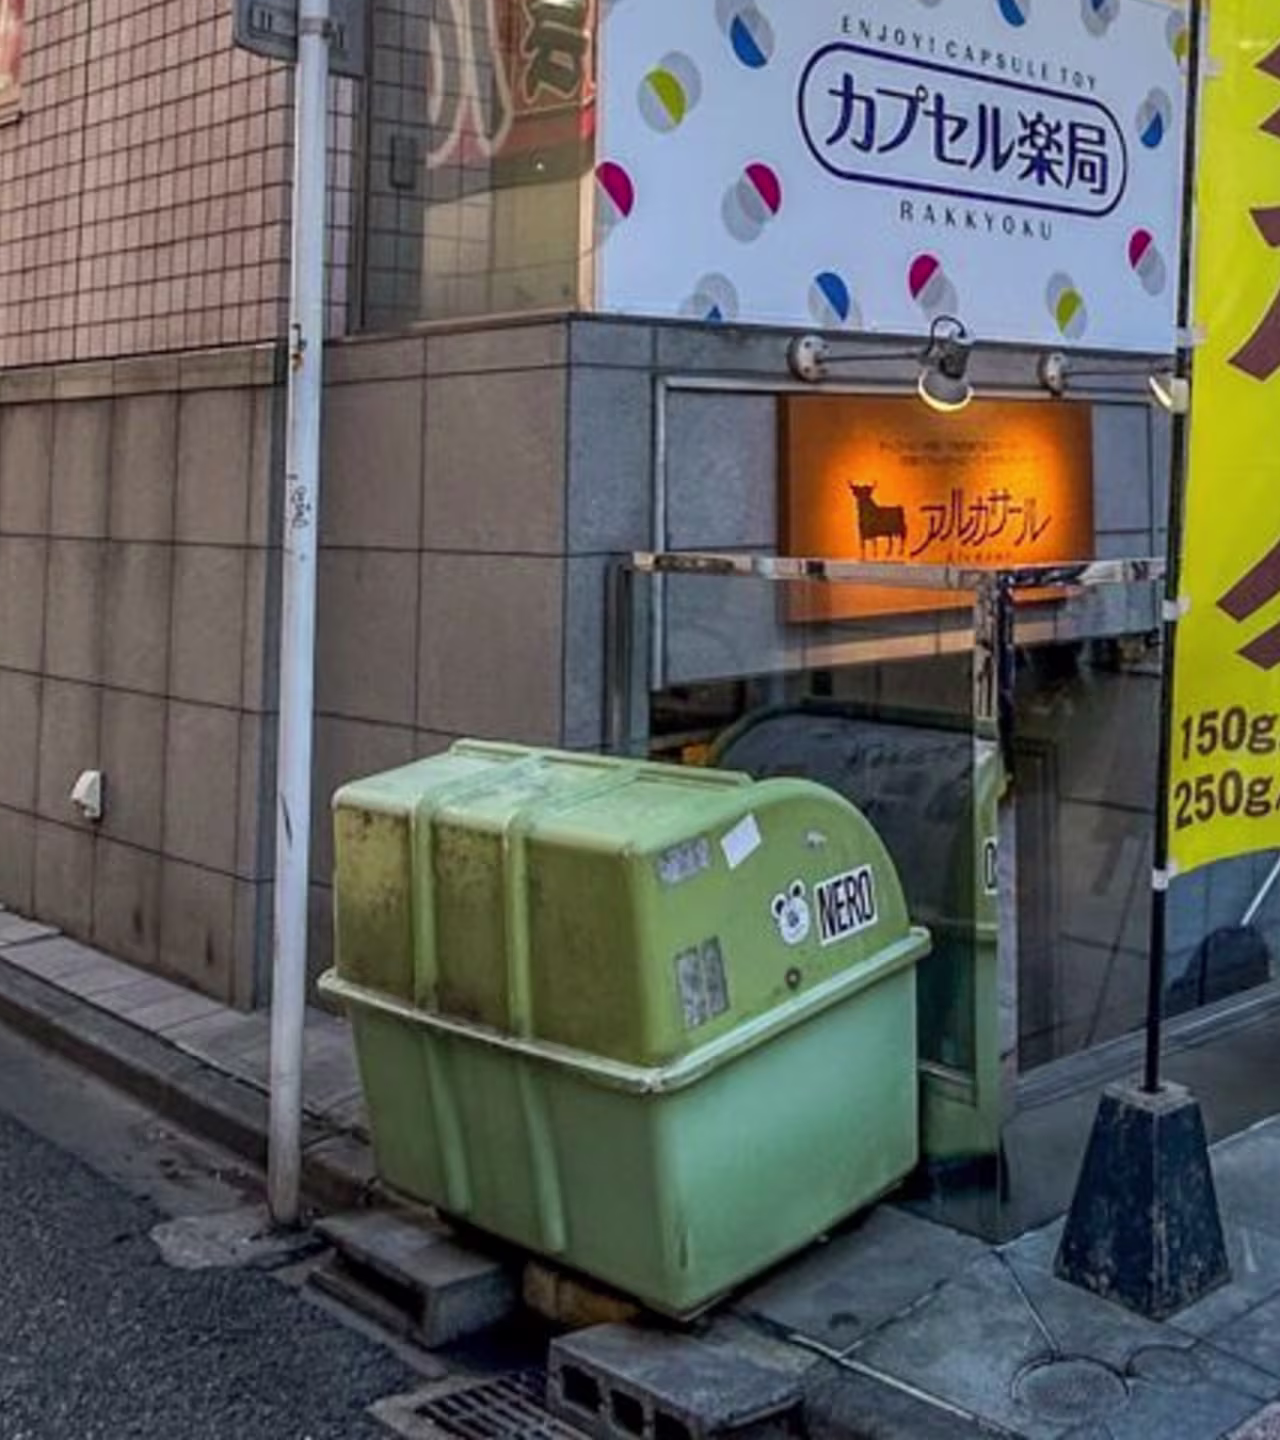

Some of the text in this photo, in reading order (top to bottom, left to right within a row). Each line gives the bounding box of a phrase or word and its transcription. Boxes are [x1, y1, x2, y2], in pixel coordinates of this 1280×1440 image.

[841, 15, 1097, 92] ENJOY! CAPSULE TOY
[825, 72, 1109, 196] カプセル楽局
[900, 199, 1054, 242] RAKKYOKU
[909, 486, 1053, 560] アルカサール
[817, 868, 875, 941] NERO
